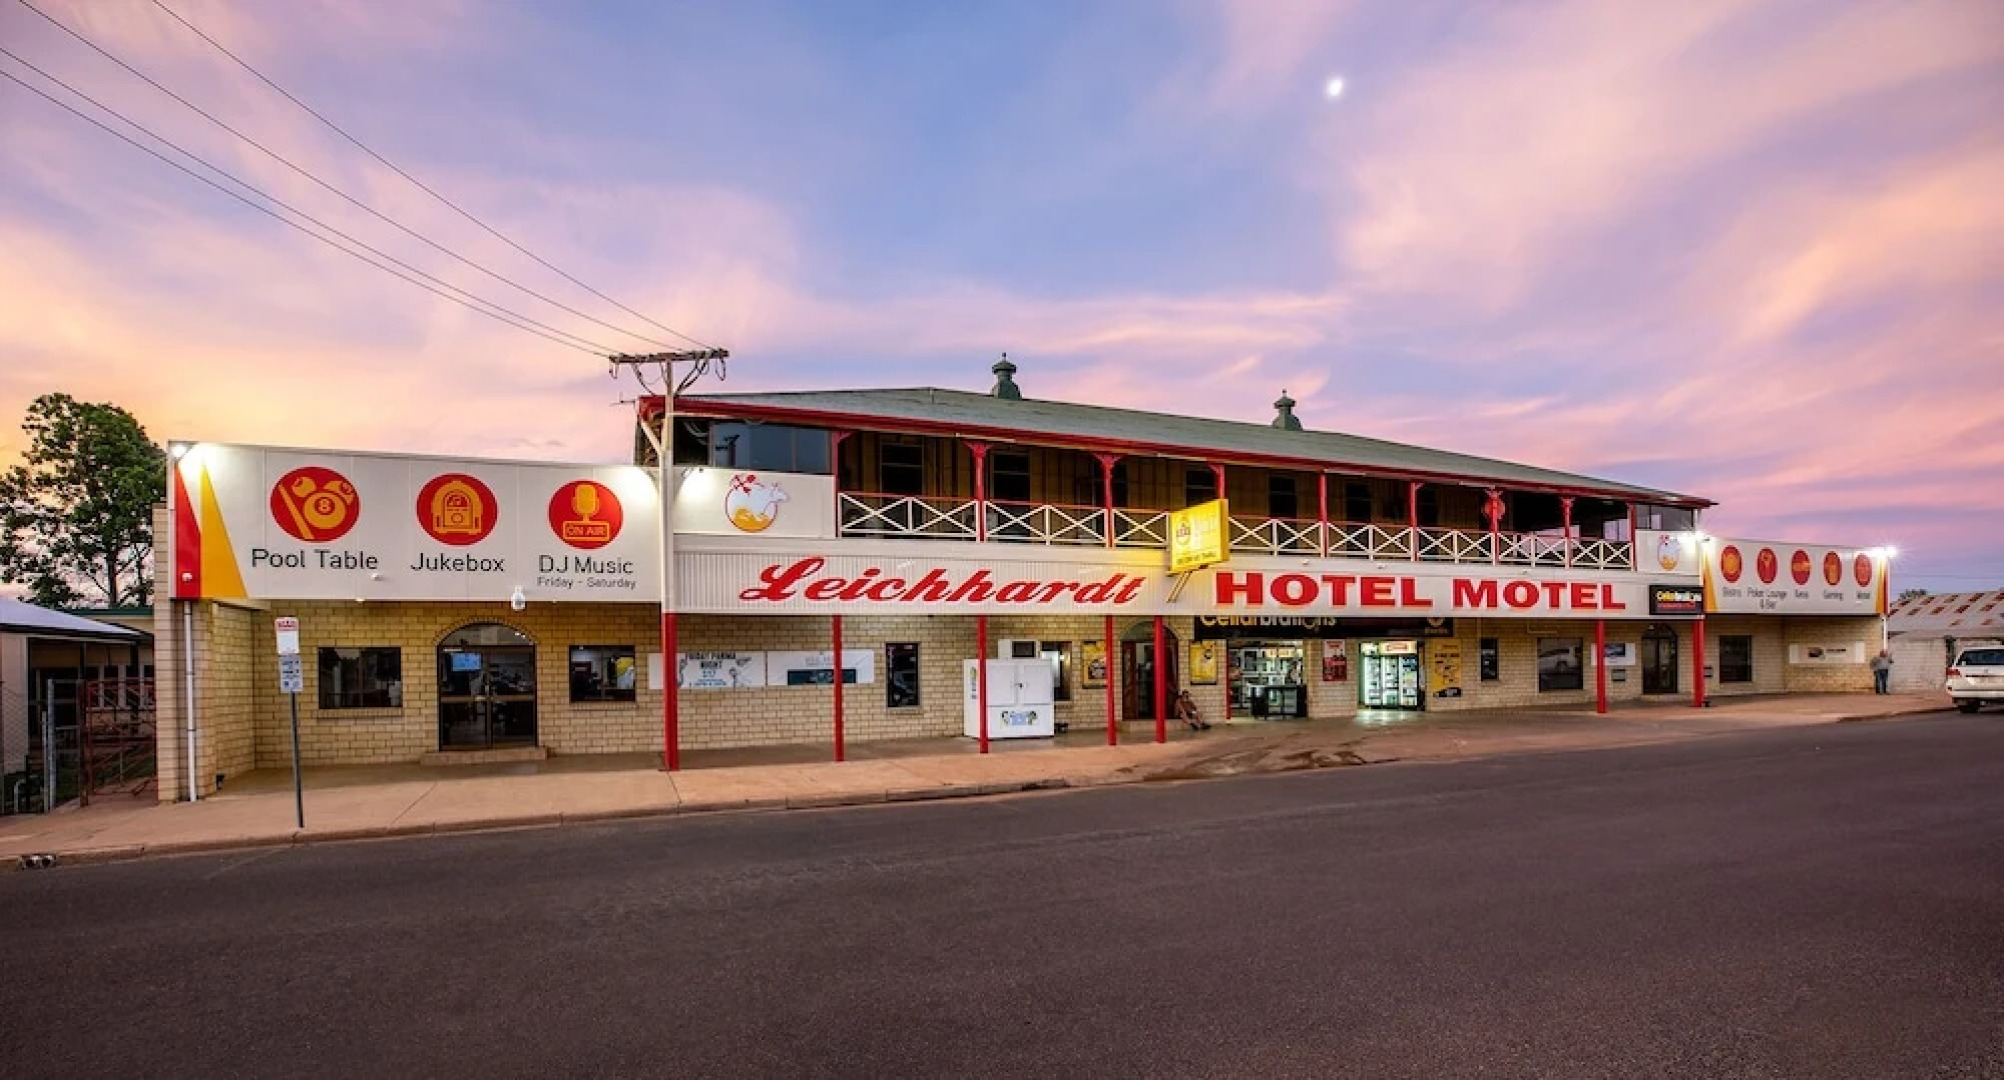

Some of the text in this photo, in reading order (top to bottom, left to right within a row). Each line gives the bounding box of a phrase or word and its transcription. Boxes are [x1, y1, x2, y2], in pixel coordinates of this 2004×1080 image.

[566, 524, 604, 536] ON AIR
[251, 548, 379, 570] Pool Table
[410, 552, 505, 572] Jukebox
[538, 555, 634, 575] DJ Music
[537, 577, 574, 589] Friday
[587, 577, 636, 590] Saturday
[738, 556, 1147, 604] Leichhardt
[1215, 572, 1626, 610] HOTEL MOTEL
